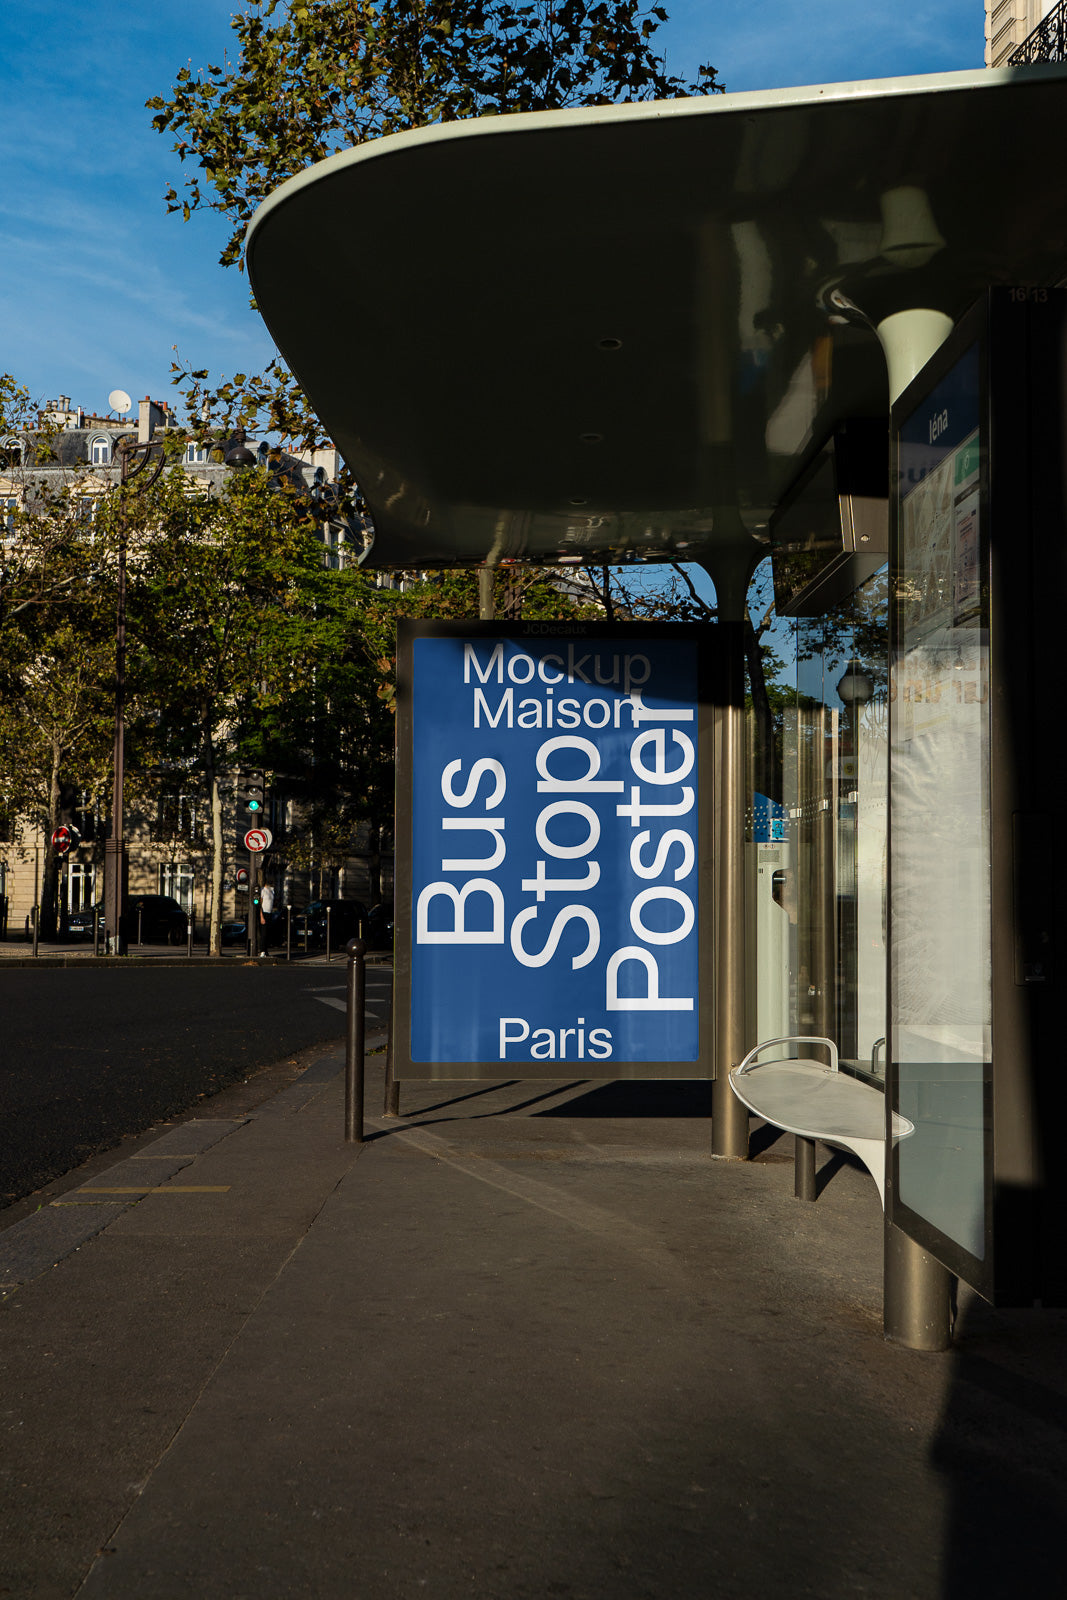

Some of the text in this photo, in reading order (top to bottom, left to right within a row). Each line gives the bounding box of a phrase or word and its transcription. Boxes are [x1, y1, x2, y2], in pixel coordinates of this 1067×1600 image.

[929, 408, 948, 444] Iéna
[523, 624, 587, 635] JCDecaux
[464, 644, 651, 695] Mockup
[474, 688, 639, 728] Maison
[417, 758, 506, 945] Bus
[510, 735, 624, 970] Stop
[606, 688, 695, 1011] Poster
[499, 1018, 613, 1060] Paris
